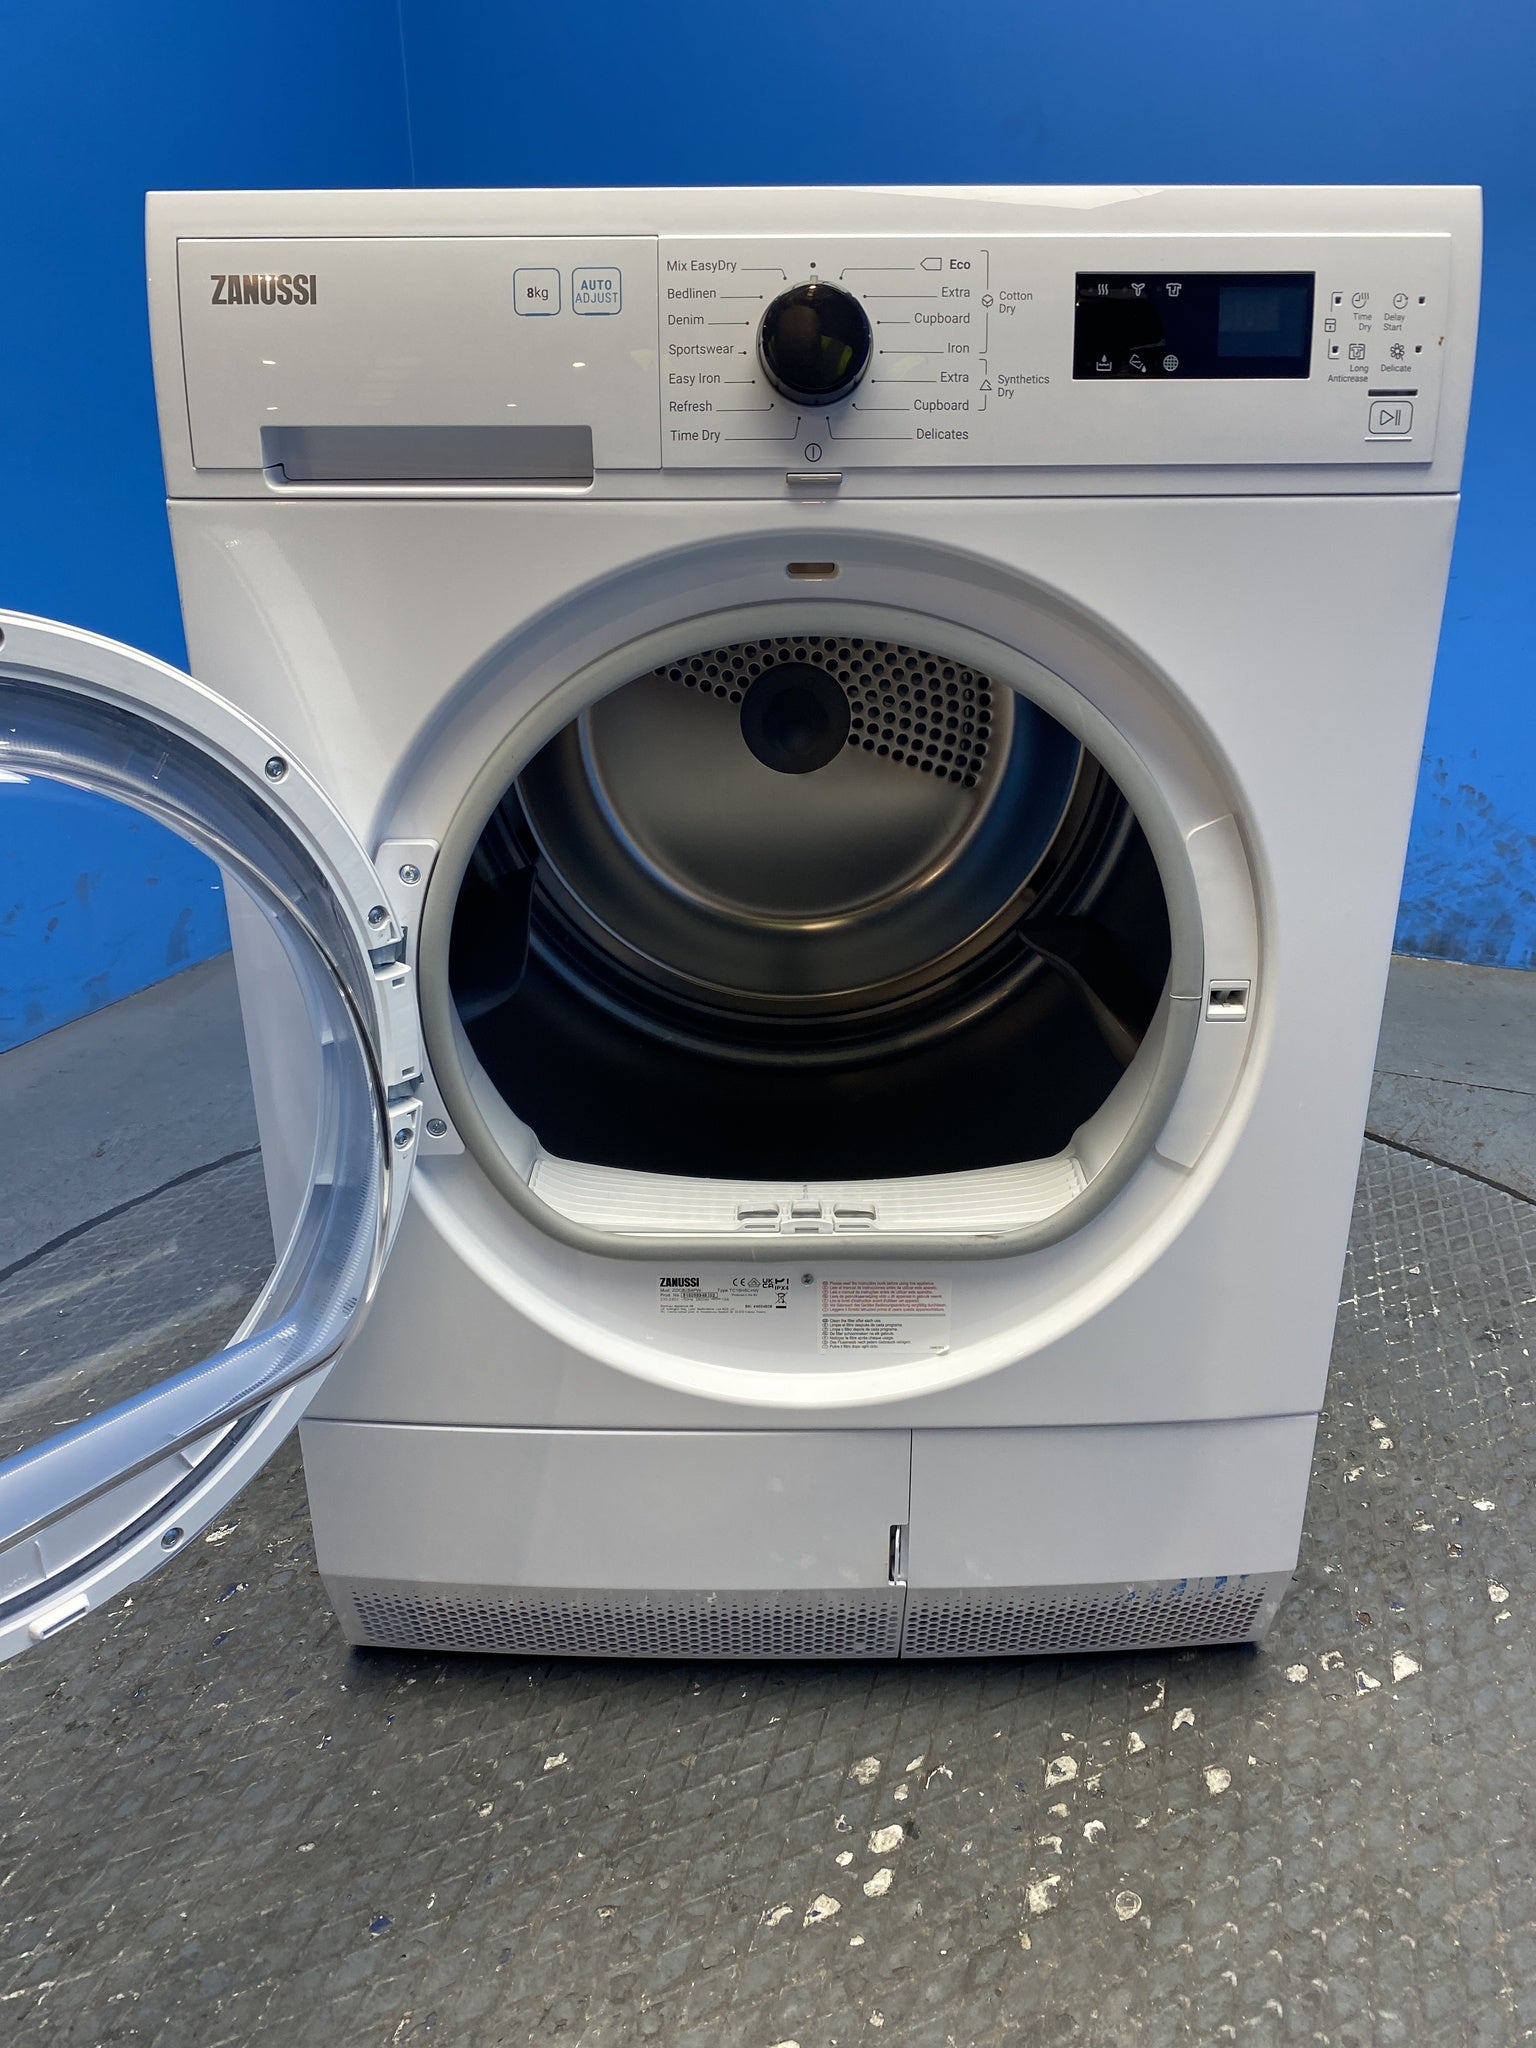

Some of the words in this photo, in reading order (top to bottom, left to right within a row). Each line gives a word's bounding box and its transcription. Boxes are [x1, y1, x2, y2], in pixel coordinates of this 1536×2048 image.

[666, 260, 687, 272] Mix
[691, 260, 737, 274] EasyDry
[949, 258, 971, 270] Eco
[210, 274, 317, 305] ZANUSSI
[580, 279, 612, 291] AUTO
[526, 286, 549, 300] 8kg
[575, 292, 619, 304] ADJUST
[667, 288, 717, 300] Bedlinen
[942, 286, 970, 298] Extra
[999, 290, 1033, 301] Cotton
[999, 304, 1016, 316] Dry
[668, 314, 704, 326] Denim
[914, 312, 970, 326] Cupboard
[1354, 312, 1372, 321] Time
[1384, 312, 1406, 322] Delay
[1358, 322, 1372, 332] Dry
[1384, 322, 1402, 331] Start
[668, 344, 734, 358] Sportswear
[948, 342, 970, 354] Iron
[1350, 364, 1369, 374] Long
[1380, 364, 1412, 372] Delicate
[668, 373, 696, 386] Easy
[698, 372, 721, 384] Iron
[940, 372, 970, 383] Extra
[998, 374, 1050, 386] Synthetics
[1328, 374, 1368, 383] Anticrease
[998, 387, 1015, 400] Dry
[669, 400, 713, 412] Refresh
[914, 399, 970, 413] Cupboard
[670, 430, 699, 441] Time
[702, 430, 721, 443] Dry
[916, 428, 969, 440] Delicates
[660, 1278, 700, 1287] ZANUSSI
